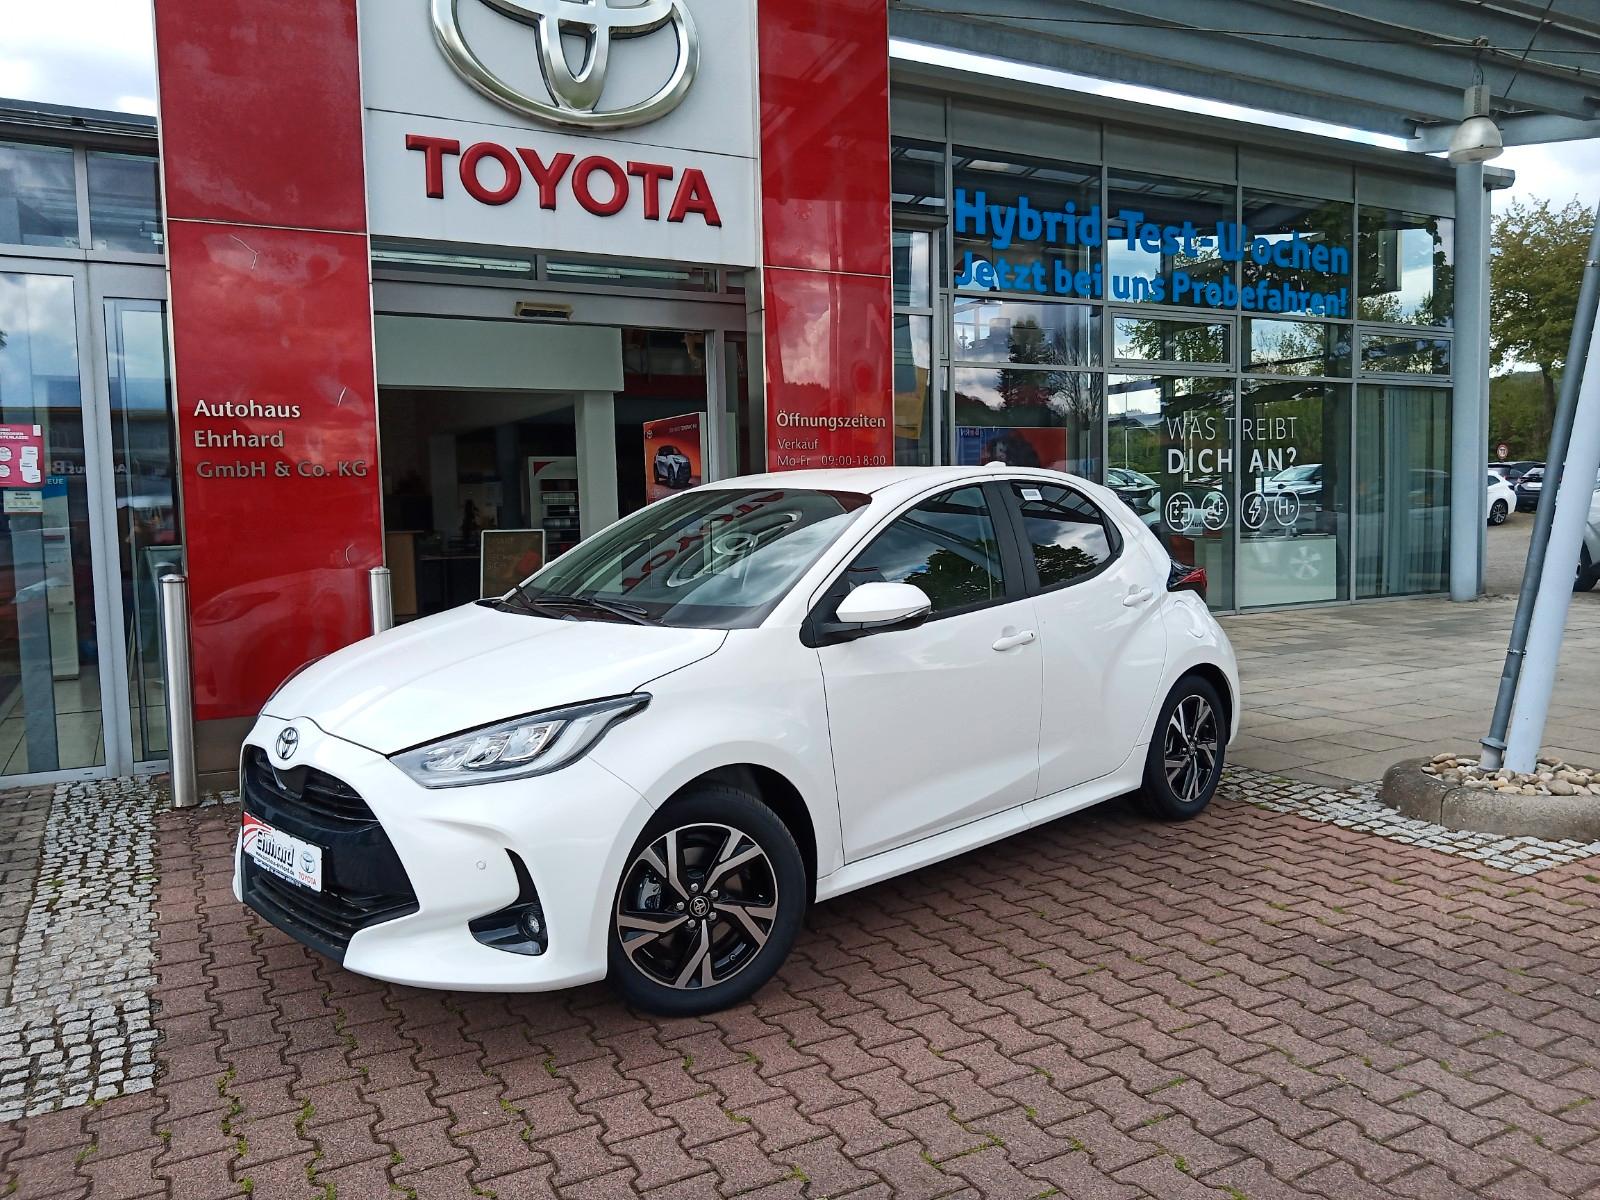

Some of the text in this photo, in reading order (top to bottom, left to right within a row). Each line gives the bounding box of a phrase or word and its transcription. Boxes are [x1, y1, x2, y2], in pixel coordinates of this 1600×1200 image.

[405, 133, 722, 228] TOYOTA
[954, 250, 1348, 317] Jetzt bei uns Probefahren!
[193, 400, 301, 418] Autohaus
[776, 410, 886, 431] Öffnungszeiten
[1167, 416, 1216, 440] WAS
[194, 429, 285, 448] Ehrhard
[777, 438, 818, 450] Verkauf
[196, 460, 367, 478] GmbH & Co. KG
[777, 455, 887, 467] Mo-Fr 09:00-18:00
[1167, 446, 1298, 474] DICH AN?
[298, 871, 317, 886] TOYOTA
